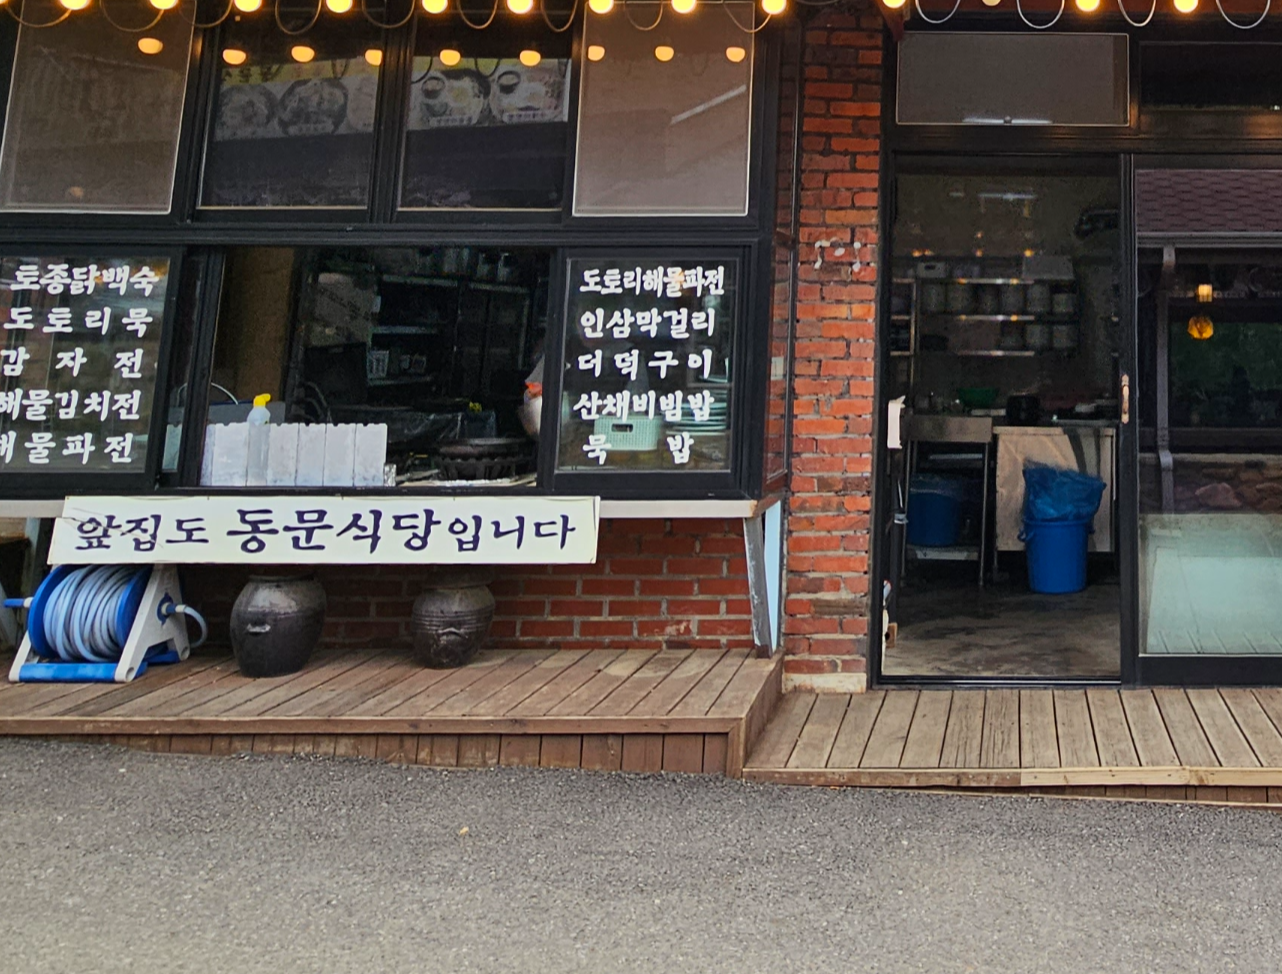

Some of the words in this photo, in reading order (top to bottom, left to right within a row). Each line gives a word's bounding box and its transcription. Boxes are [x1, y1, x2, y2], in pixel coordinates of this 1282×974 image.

[10, 264, 160, 297] 토종닭백숙
[579, 266, 725, 297] 도토리해물파전
[4, 307, 153, 338] 도토리묵
[580, 308, 716, 338] 인삼막걸리
[0, 347, 144, 378] 감자전
[577, 349, 713, 380] 더덕구이
[0, 388, 142, 421] 해물김치전
[573, 390, 715, 422] 산채비빔밥
[583, 432, 694, 465] 묵밥
[75, 514, 209, 552] 앞집도
[226, 508, 576, 554] 동문식당입니다
